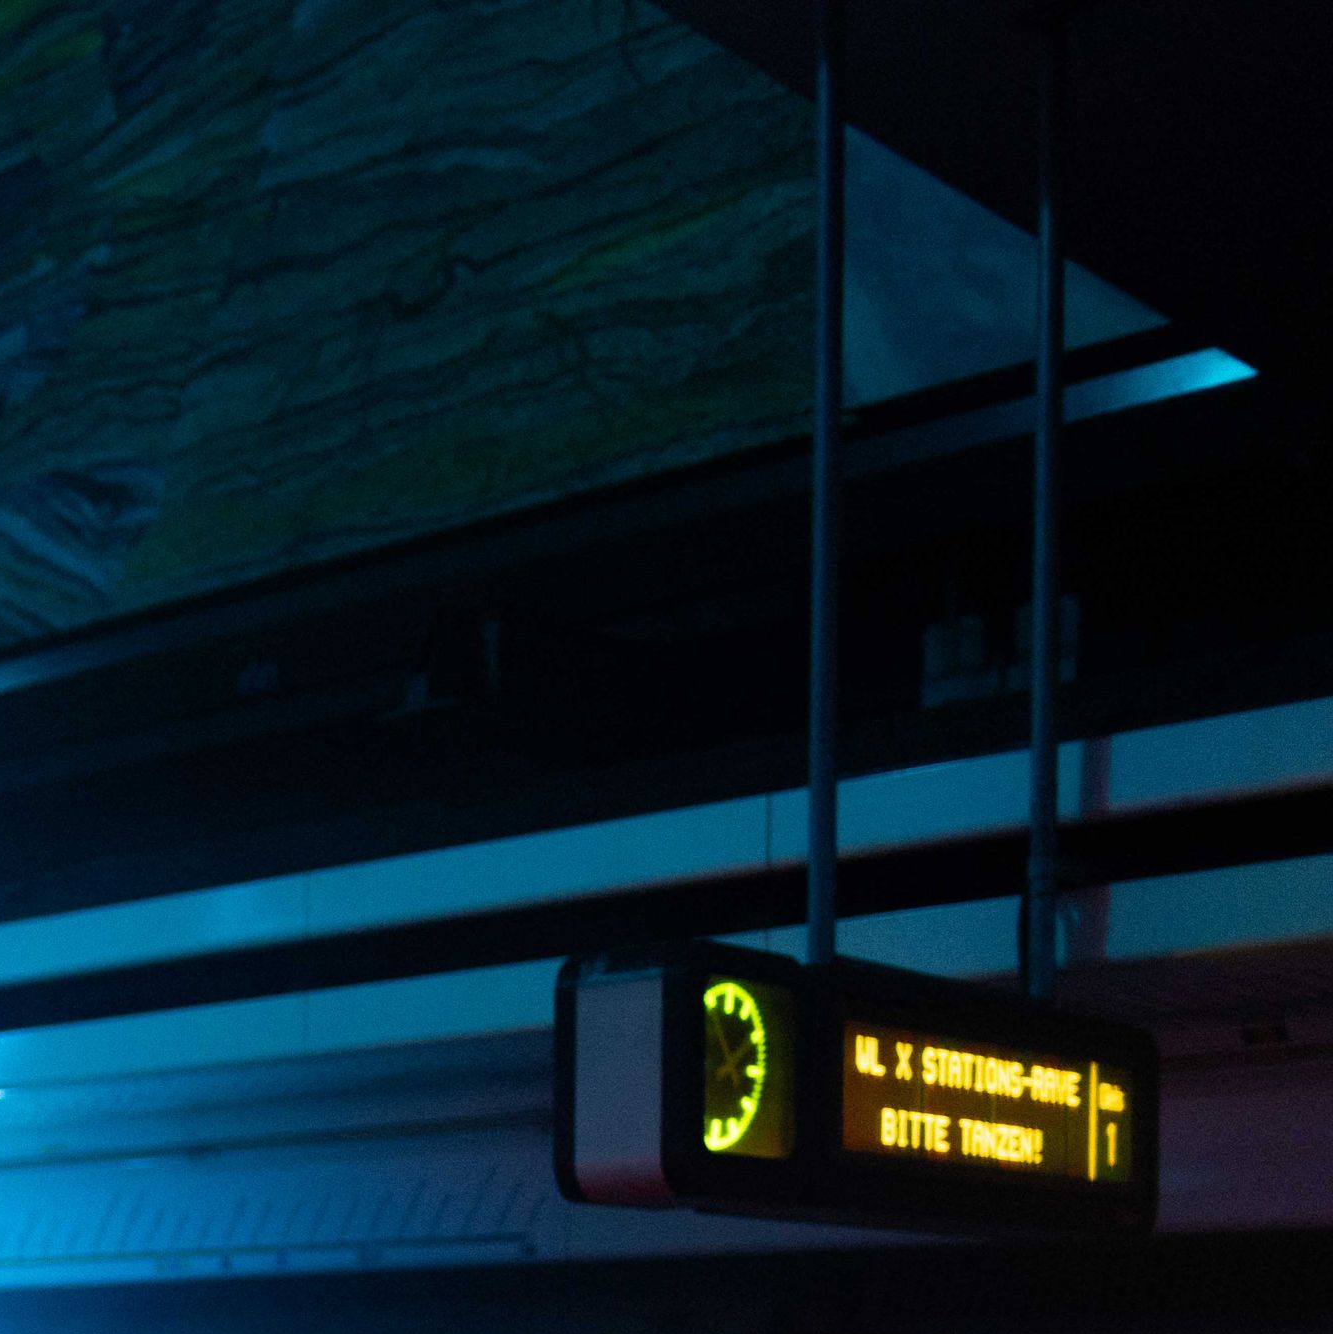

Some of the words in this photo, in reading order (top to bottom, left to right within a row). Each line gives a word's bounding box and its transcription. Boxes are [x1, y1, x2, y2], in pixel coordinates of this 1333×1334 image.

[895, 1041, 914, 1081] X
[880, 1106, 951, 1154] BITTE
[958, 1117, 1044, 1165] TANZEN!
[1106, 1122, 1118, 1166] 1
